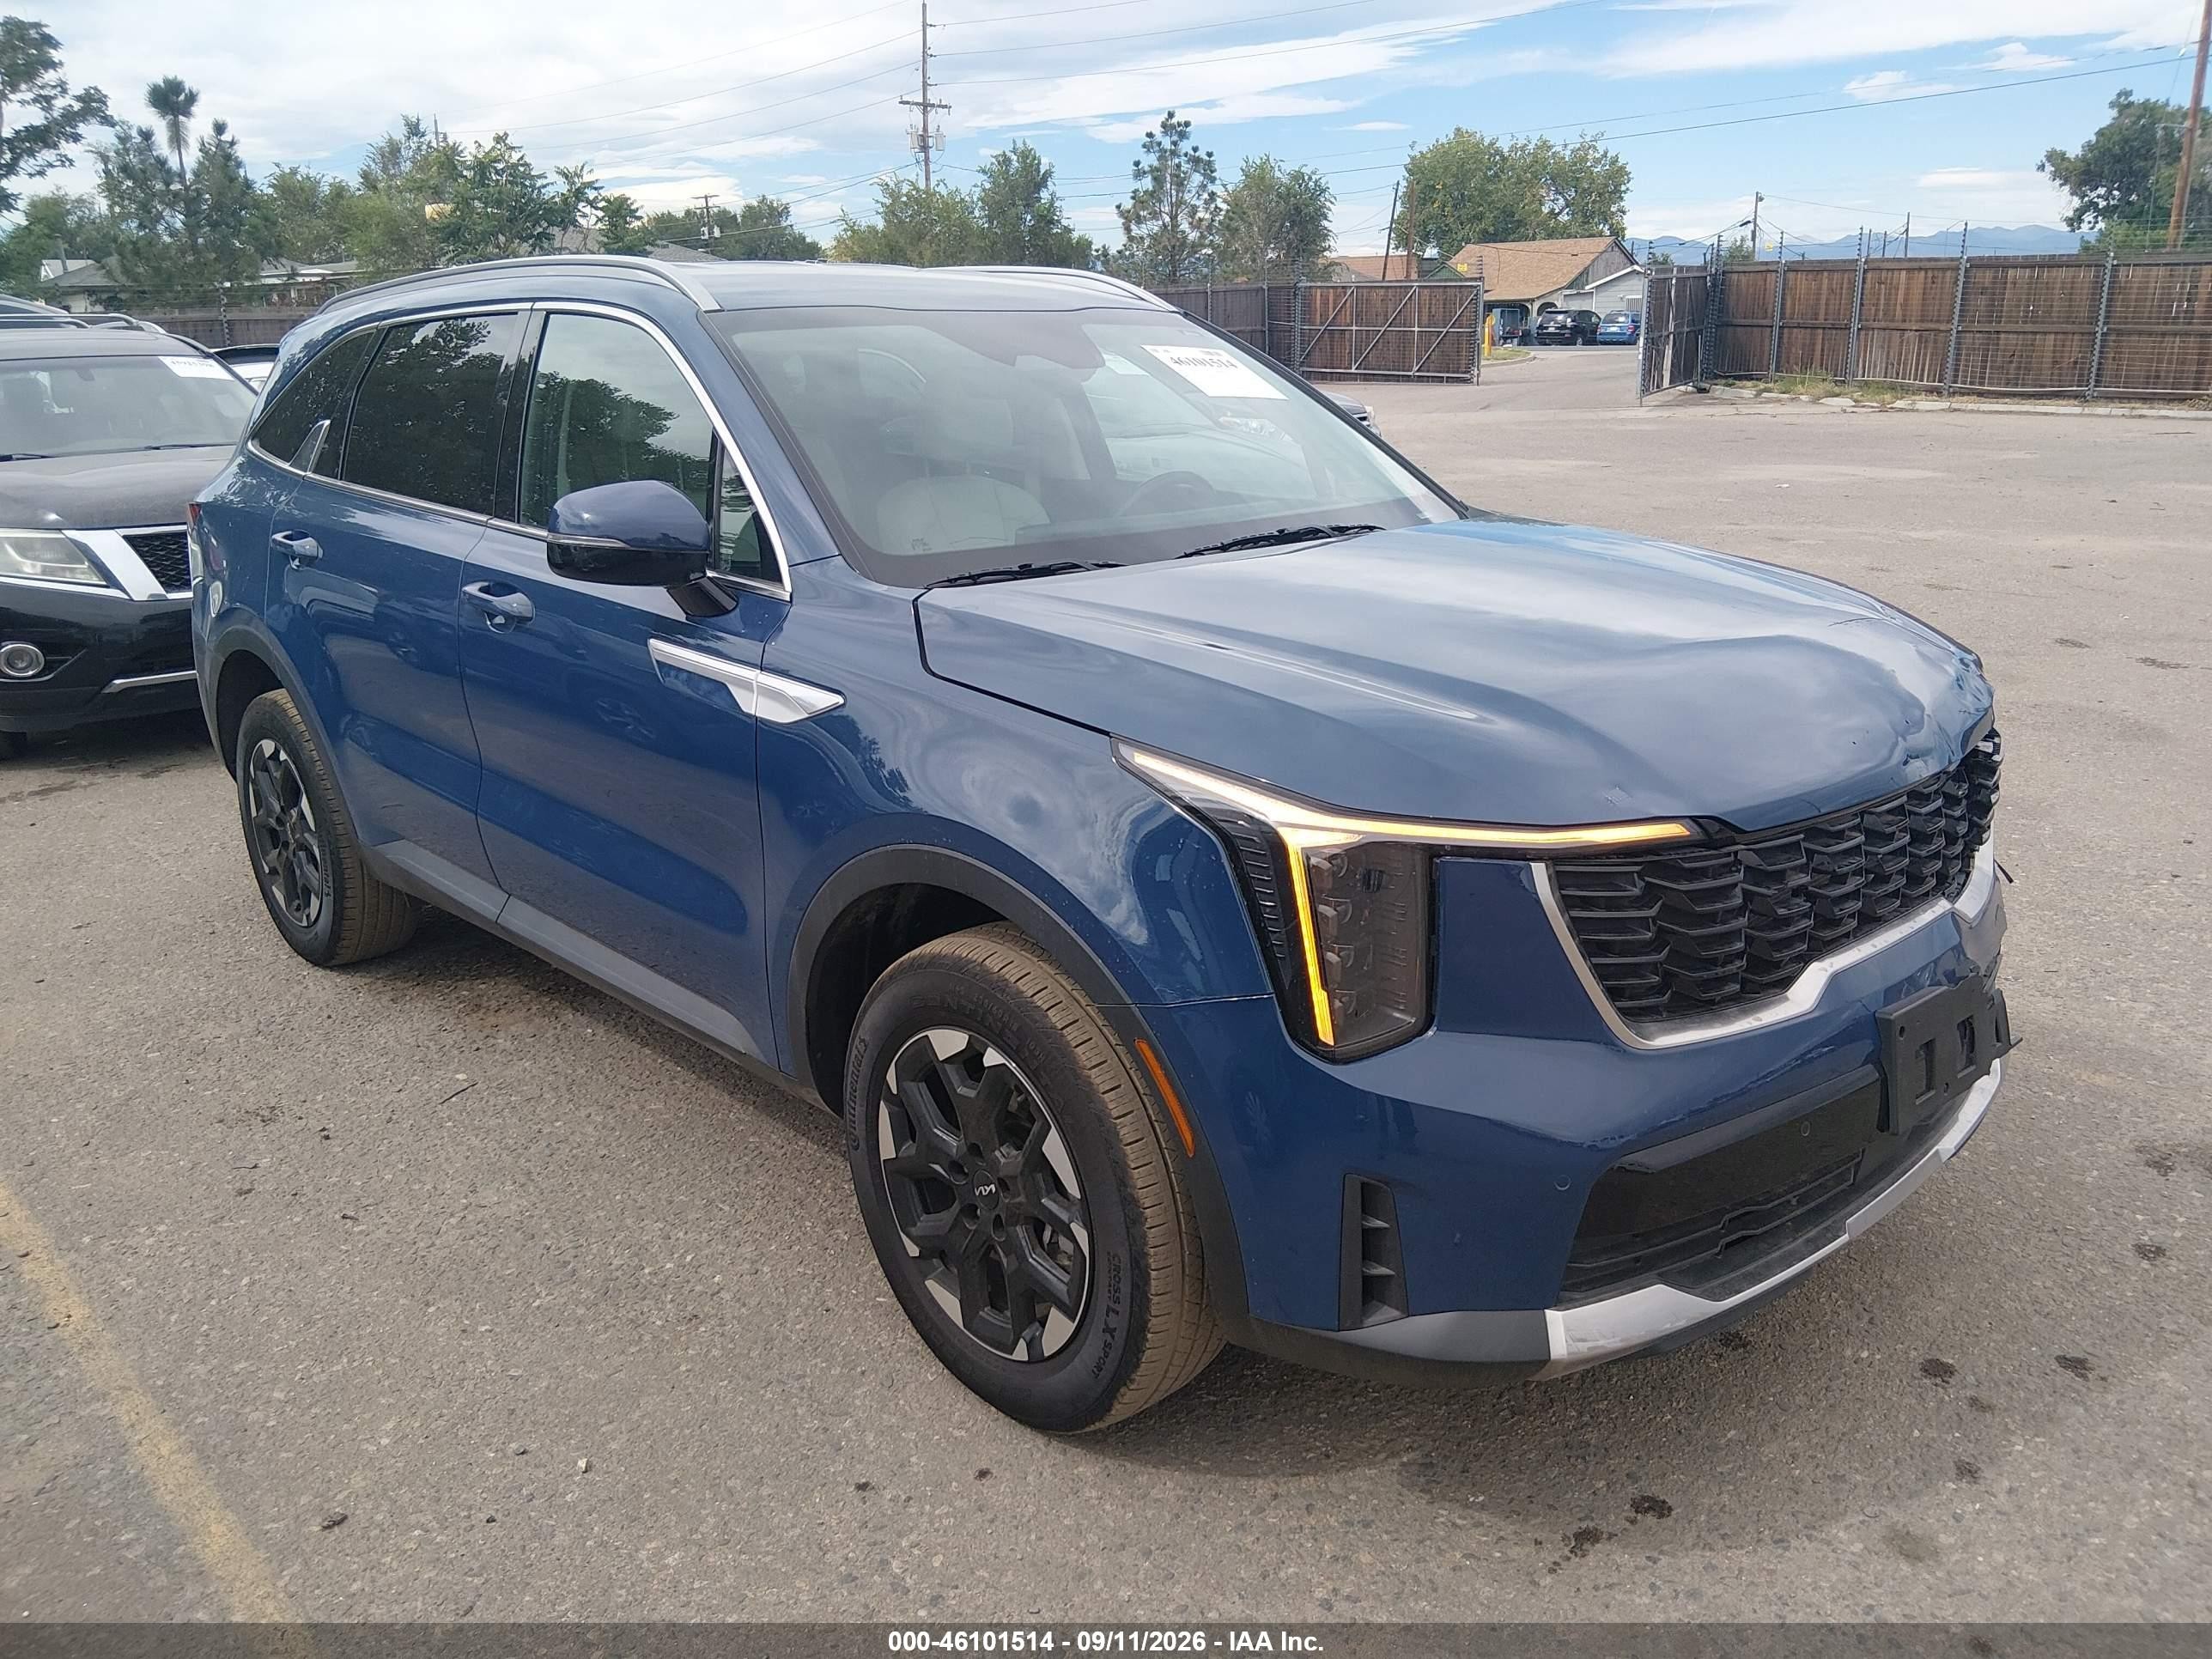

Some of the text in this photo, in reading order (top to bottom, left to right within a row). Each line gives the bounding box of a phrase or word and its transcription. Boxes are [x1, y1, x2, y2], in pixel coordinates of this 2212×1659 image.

[1170, 356, 1237, 369] 46101514
[1091, 1253, 1122, 1380] CROSS LX SPORT
